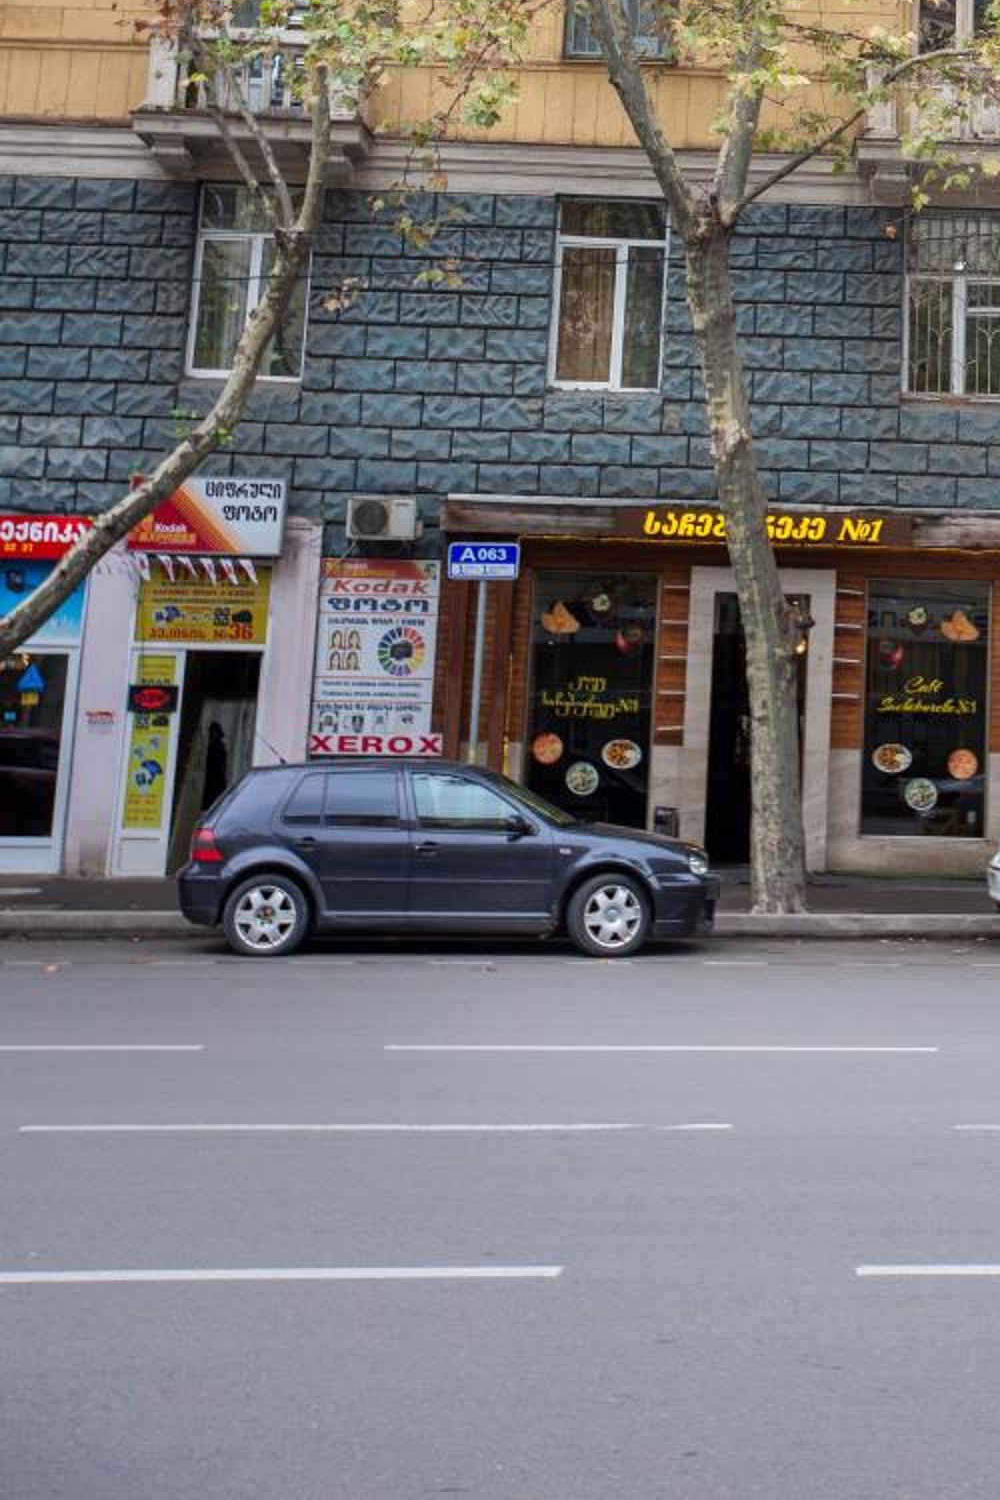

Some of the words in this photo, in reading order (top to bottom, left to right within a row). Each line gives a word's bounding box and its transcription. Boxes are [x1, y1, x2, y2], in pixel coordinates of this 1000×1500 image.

[205, 481, 282, 499] ციფრული
[222, 505, 278, 523] ფოტო
[154, 522, 188, 533] Kodak
[643, 511, 827, 541] საჩებეკე
[333, 579, 430, 595] Kodak
[327, 597, 429, 612] ფოტო
[309, 735, 441, 753] XEROX
